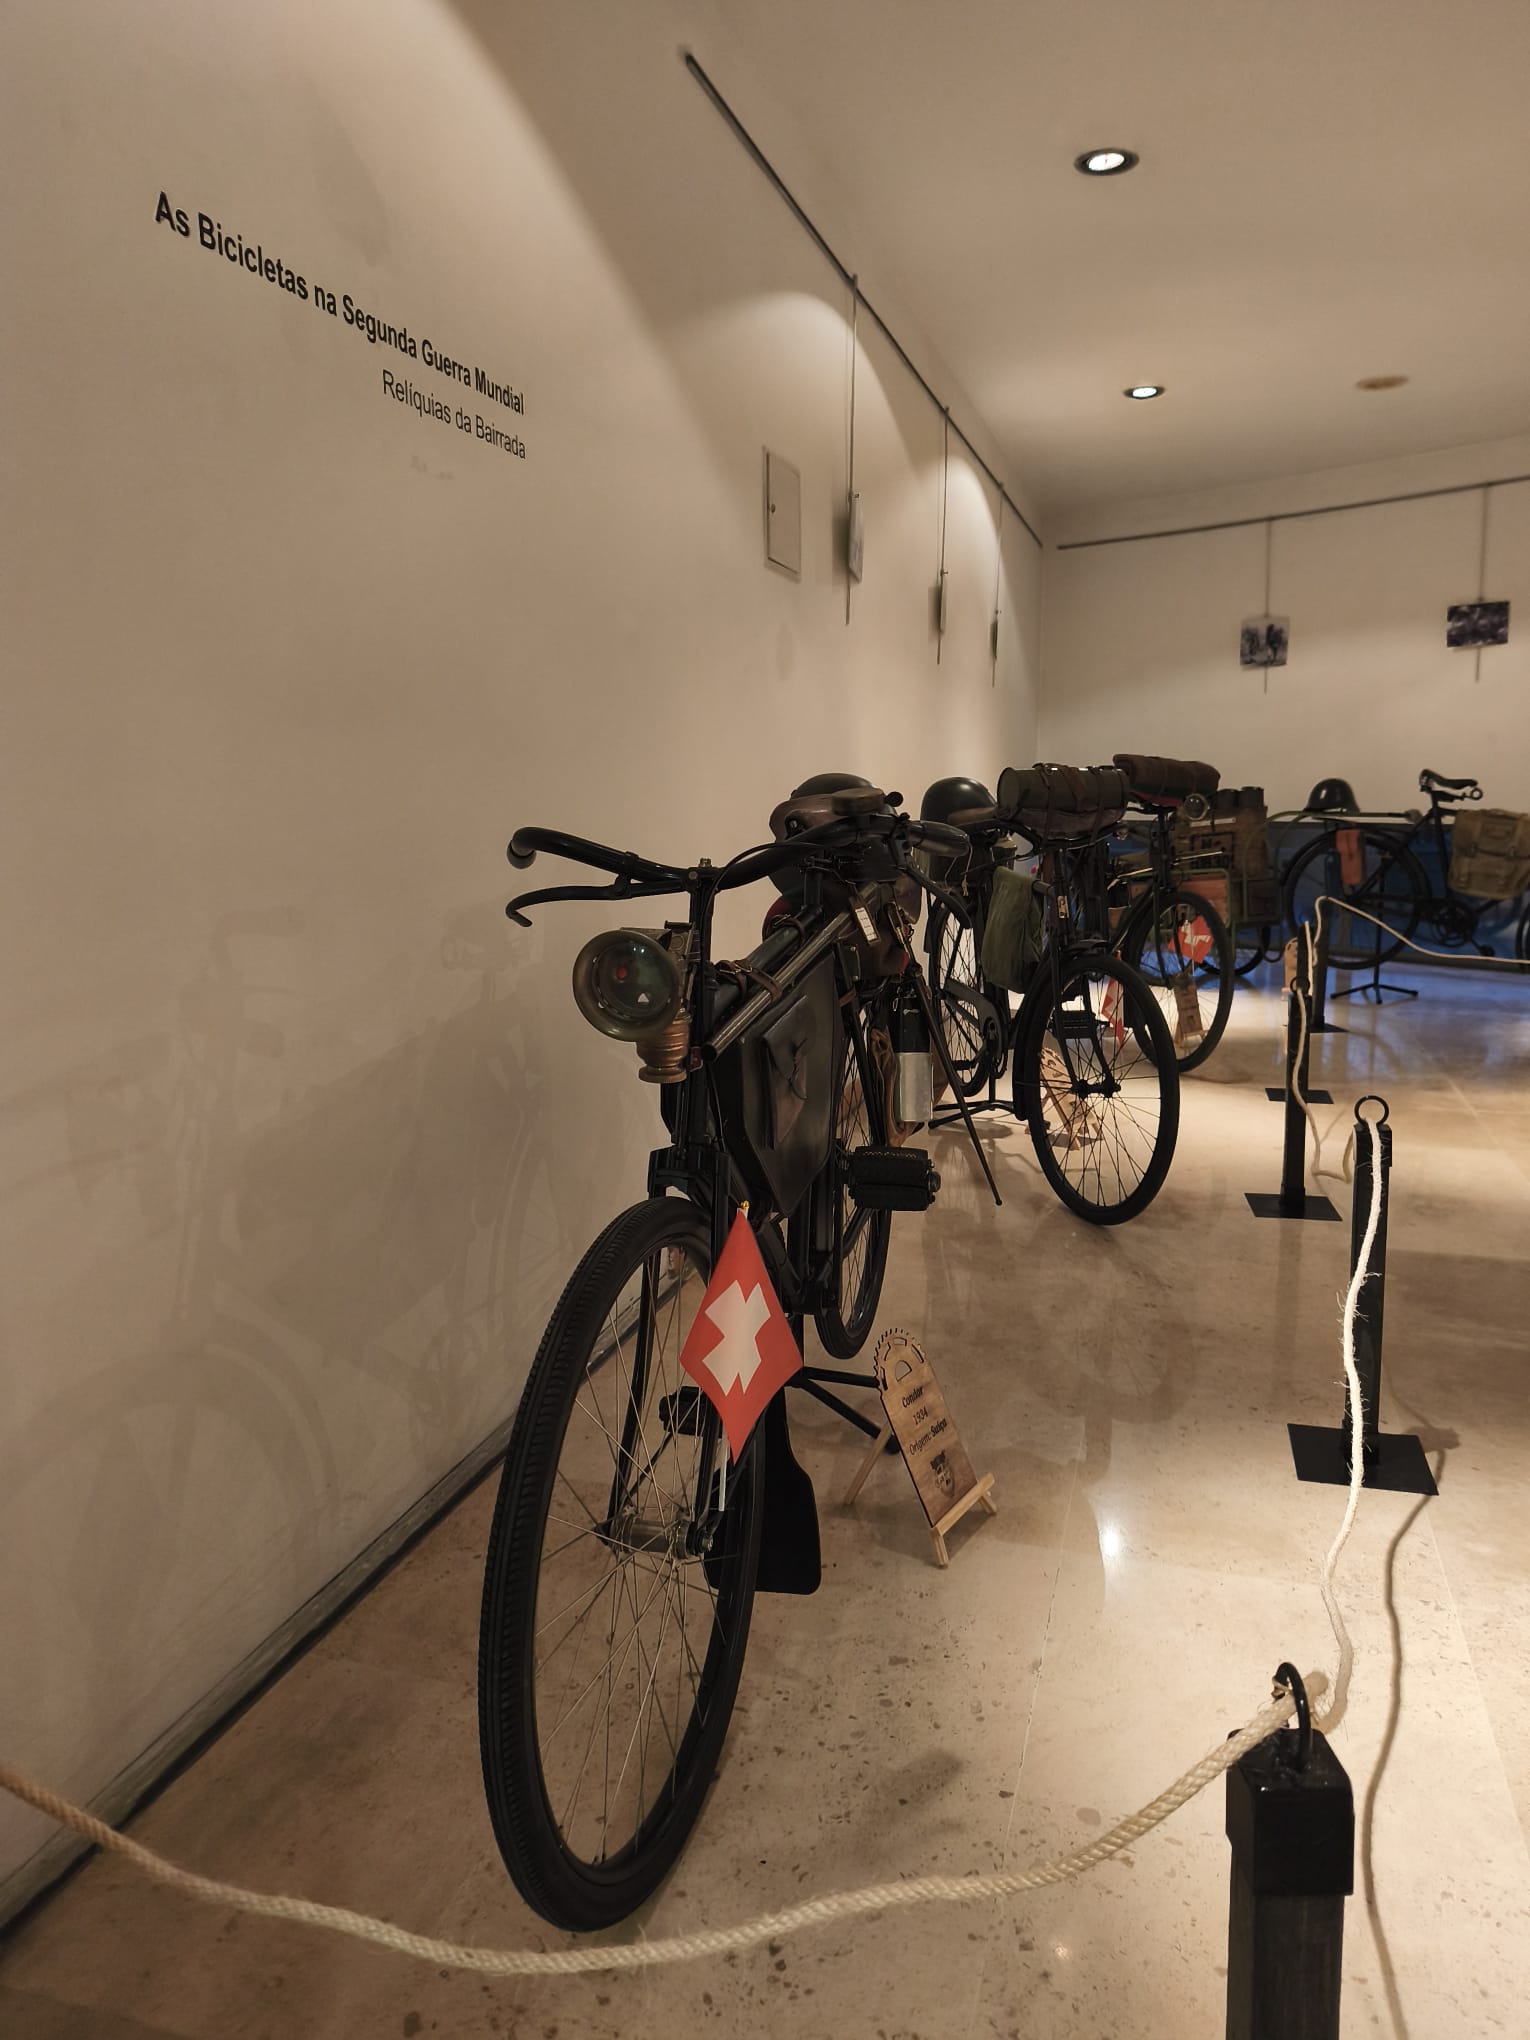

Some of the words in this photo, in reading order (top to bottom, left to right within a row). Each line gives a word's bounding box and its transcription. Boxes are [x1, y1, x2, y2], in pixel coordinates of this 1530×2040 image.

[154, 190, 191, 239] As
[198, 212, 309, 301] Bicicletas
[313, 284, 338, 318] na
[342, 294, 418, 360] Segunda
[421, 338, 472, 388] Guerra
[474, 366, 525, 417] Mundial
[382, 368, 452, 425] Relíquias
[455, 406, 473, 435] da
[474, 413, 526, 460] Bairrada
[902, 1386, 924, 1409] Condor
